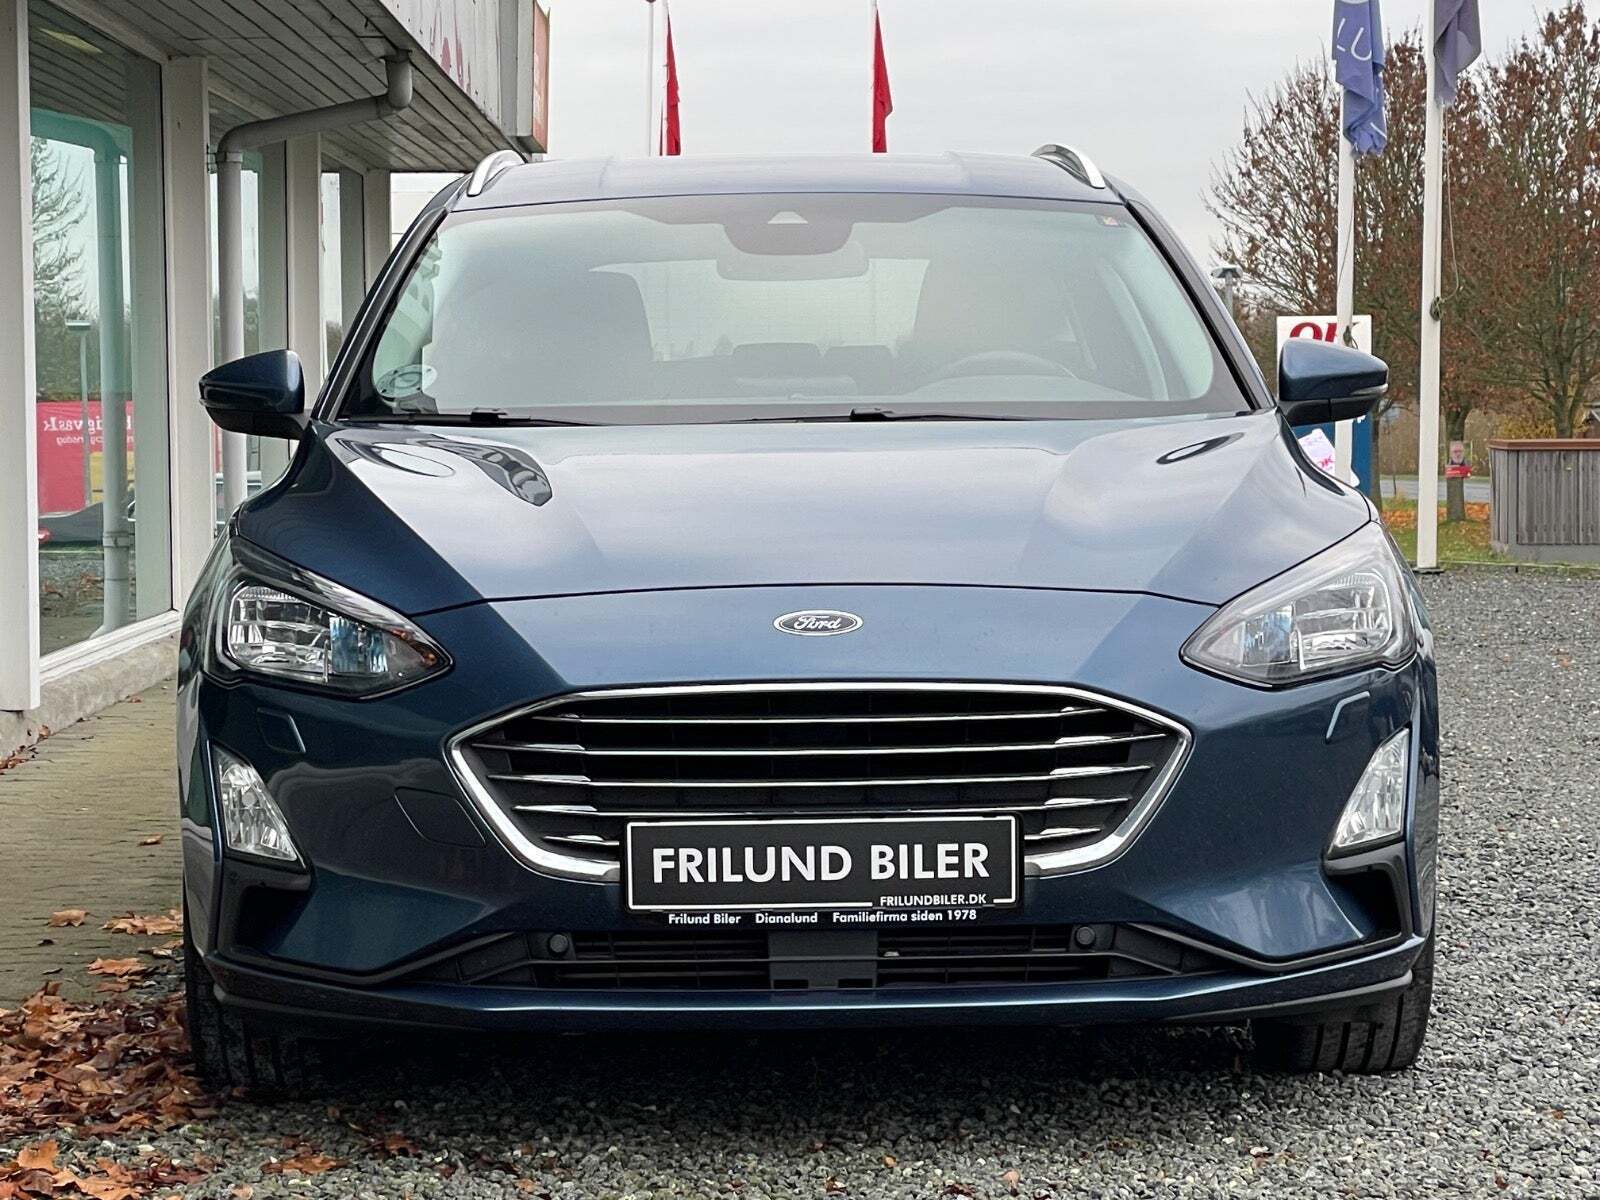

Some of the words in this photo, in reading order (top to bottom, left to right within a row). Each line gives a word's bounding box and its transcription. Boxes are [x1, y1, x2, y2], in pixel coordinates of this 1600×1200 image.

[793, 614, 842, 630] Ford
[652, 845, 853, 884] FRILUND
[870, 842, 990, 880] BILER
[879, 893, 987, 907] FRILUNDBILER.DK
[668, 913, 710, 925] Frilund
[713, 913, 742, 925] Biler
[755, 912, 818, 924] Dianalund
[832, 911, 908, 923] Familiefirma
[911, 910, 943, 922] siden
[947, 909, 977, 921] 1978
